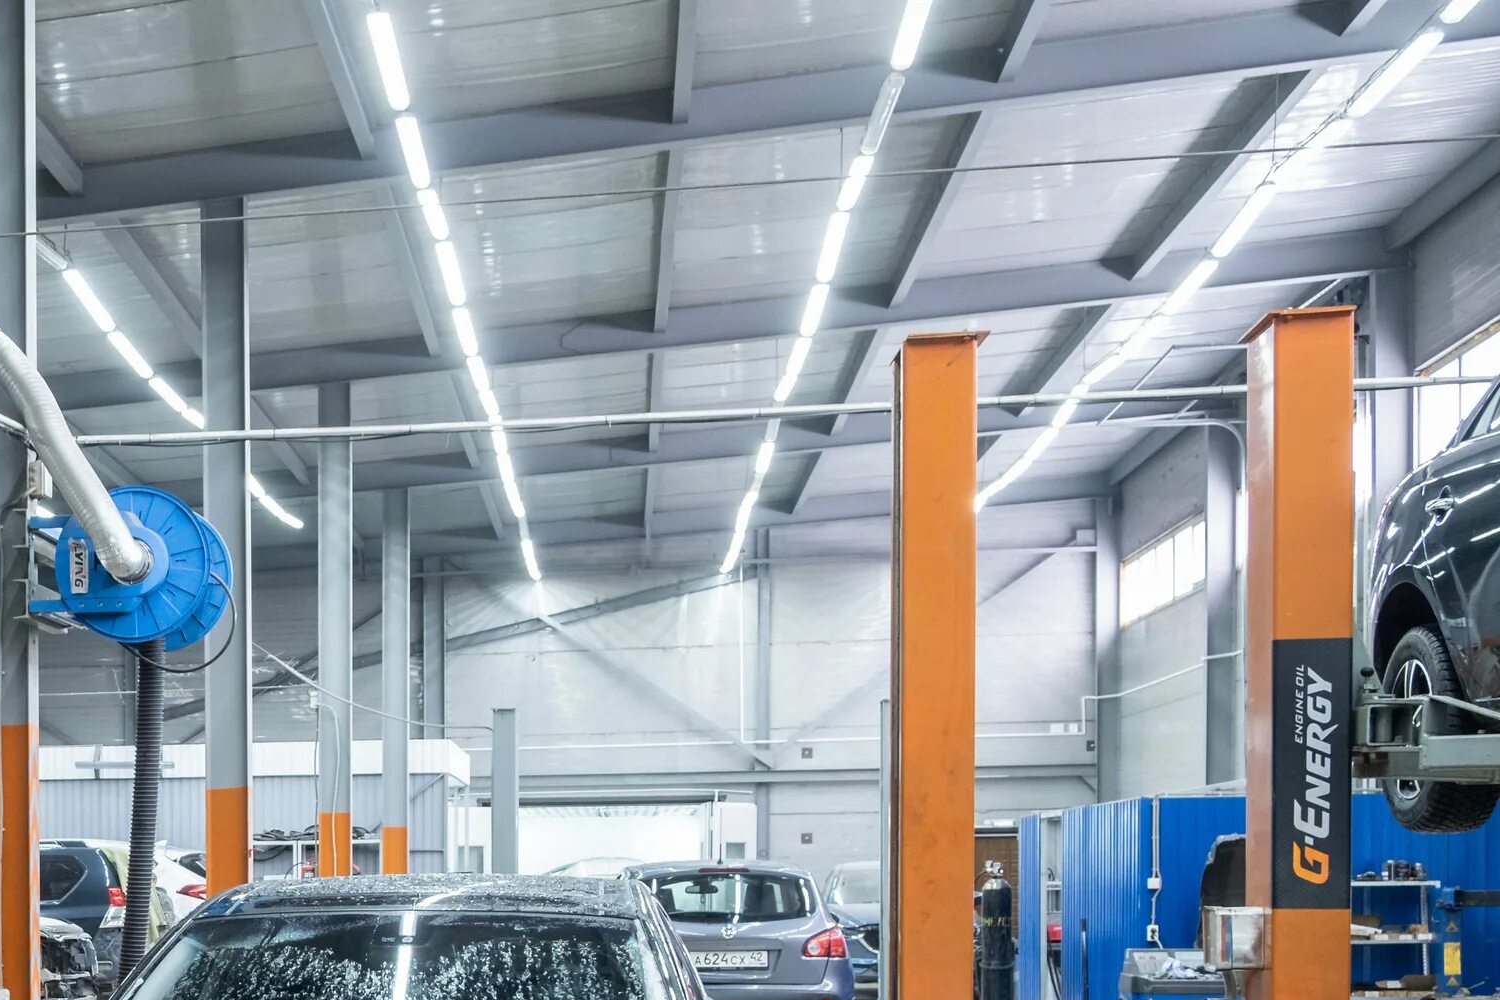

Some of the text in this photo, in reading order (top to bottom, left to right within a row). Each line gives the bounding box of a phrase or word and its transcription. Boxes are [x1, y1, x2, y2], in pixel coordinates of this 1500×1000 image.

[1294, 664, 1305, 744] ENGINE OIL
[750, 951, 763, 962] 42
